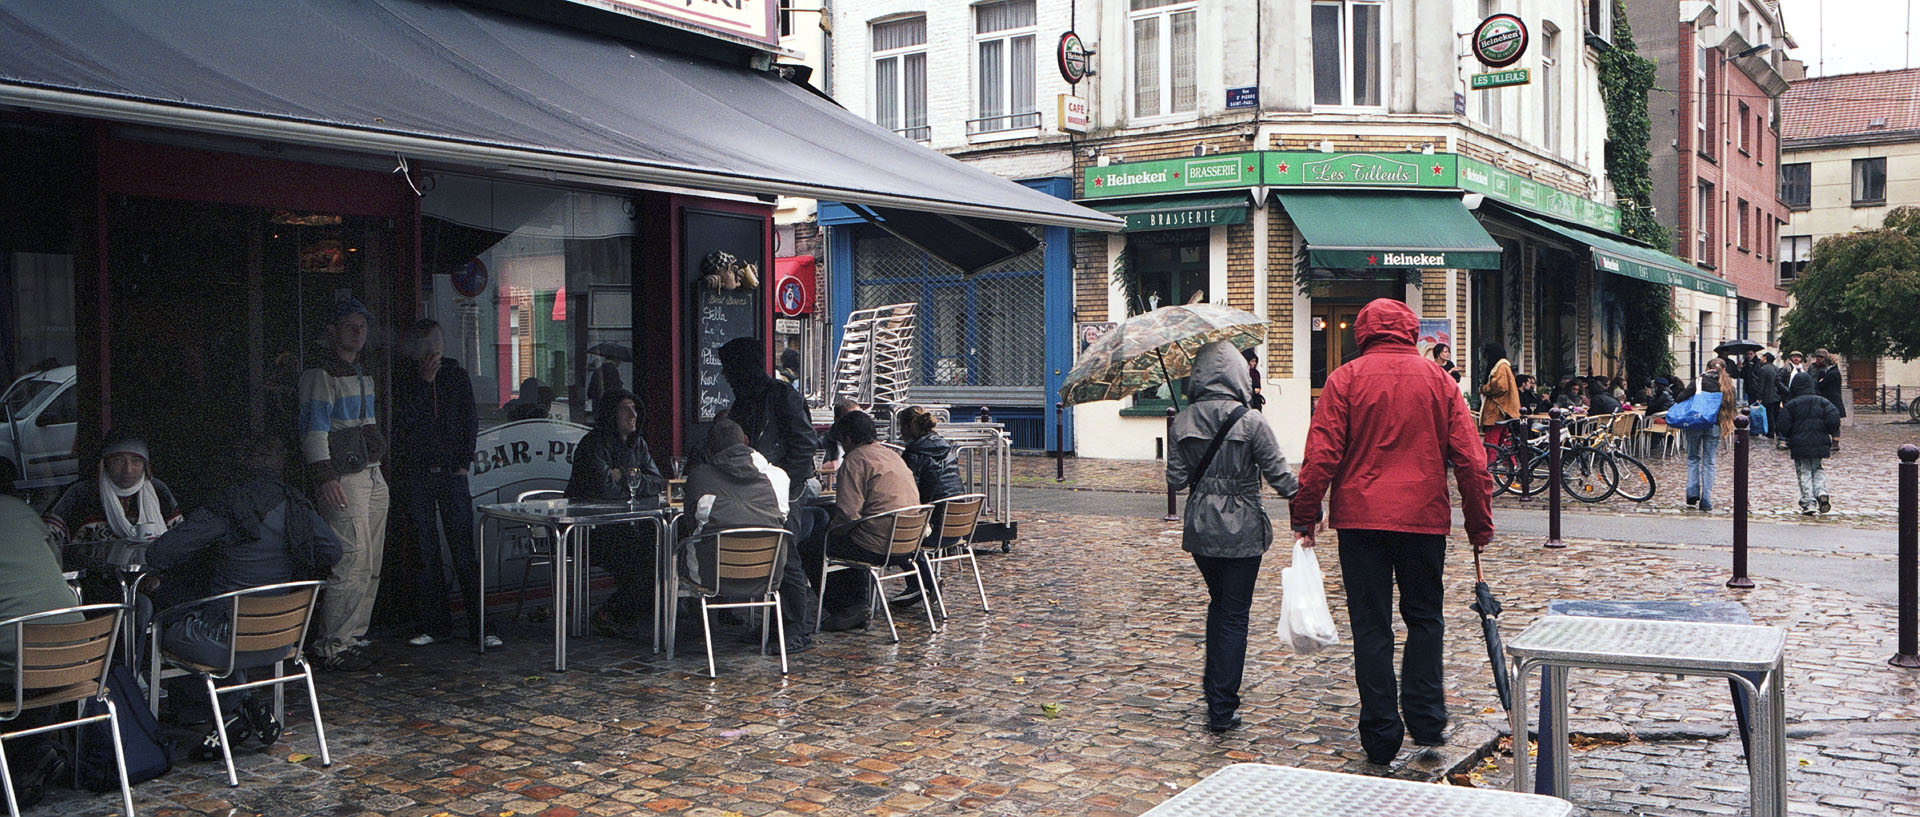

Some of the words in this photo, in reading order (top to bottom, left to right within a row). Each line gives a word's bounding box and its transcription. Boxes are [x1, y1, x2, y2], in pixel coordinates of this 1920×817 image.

[1481, 32, 1519, 48] Heineken
[1473, 76, 1488, 85] LES
[1491, 71, 1525, 84] TILLEULS
[1106, 169, 1167, 187] Heineken
[1190, 164, 1236, 179] BRASSERIE
[1312, 163, 1345, 181] Les
[1350, 163, 1410, 181] Tilleuls
[1151, 210, 1215, 227] BRASSERIE
[1383, 253, 1445, 266] Heineken
[702, 306, 728, 324] Stella
